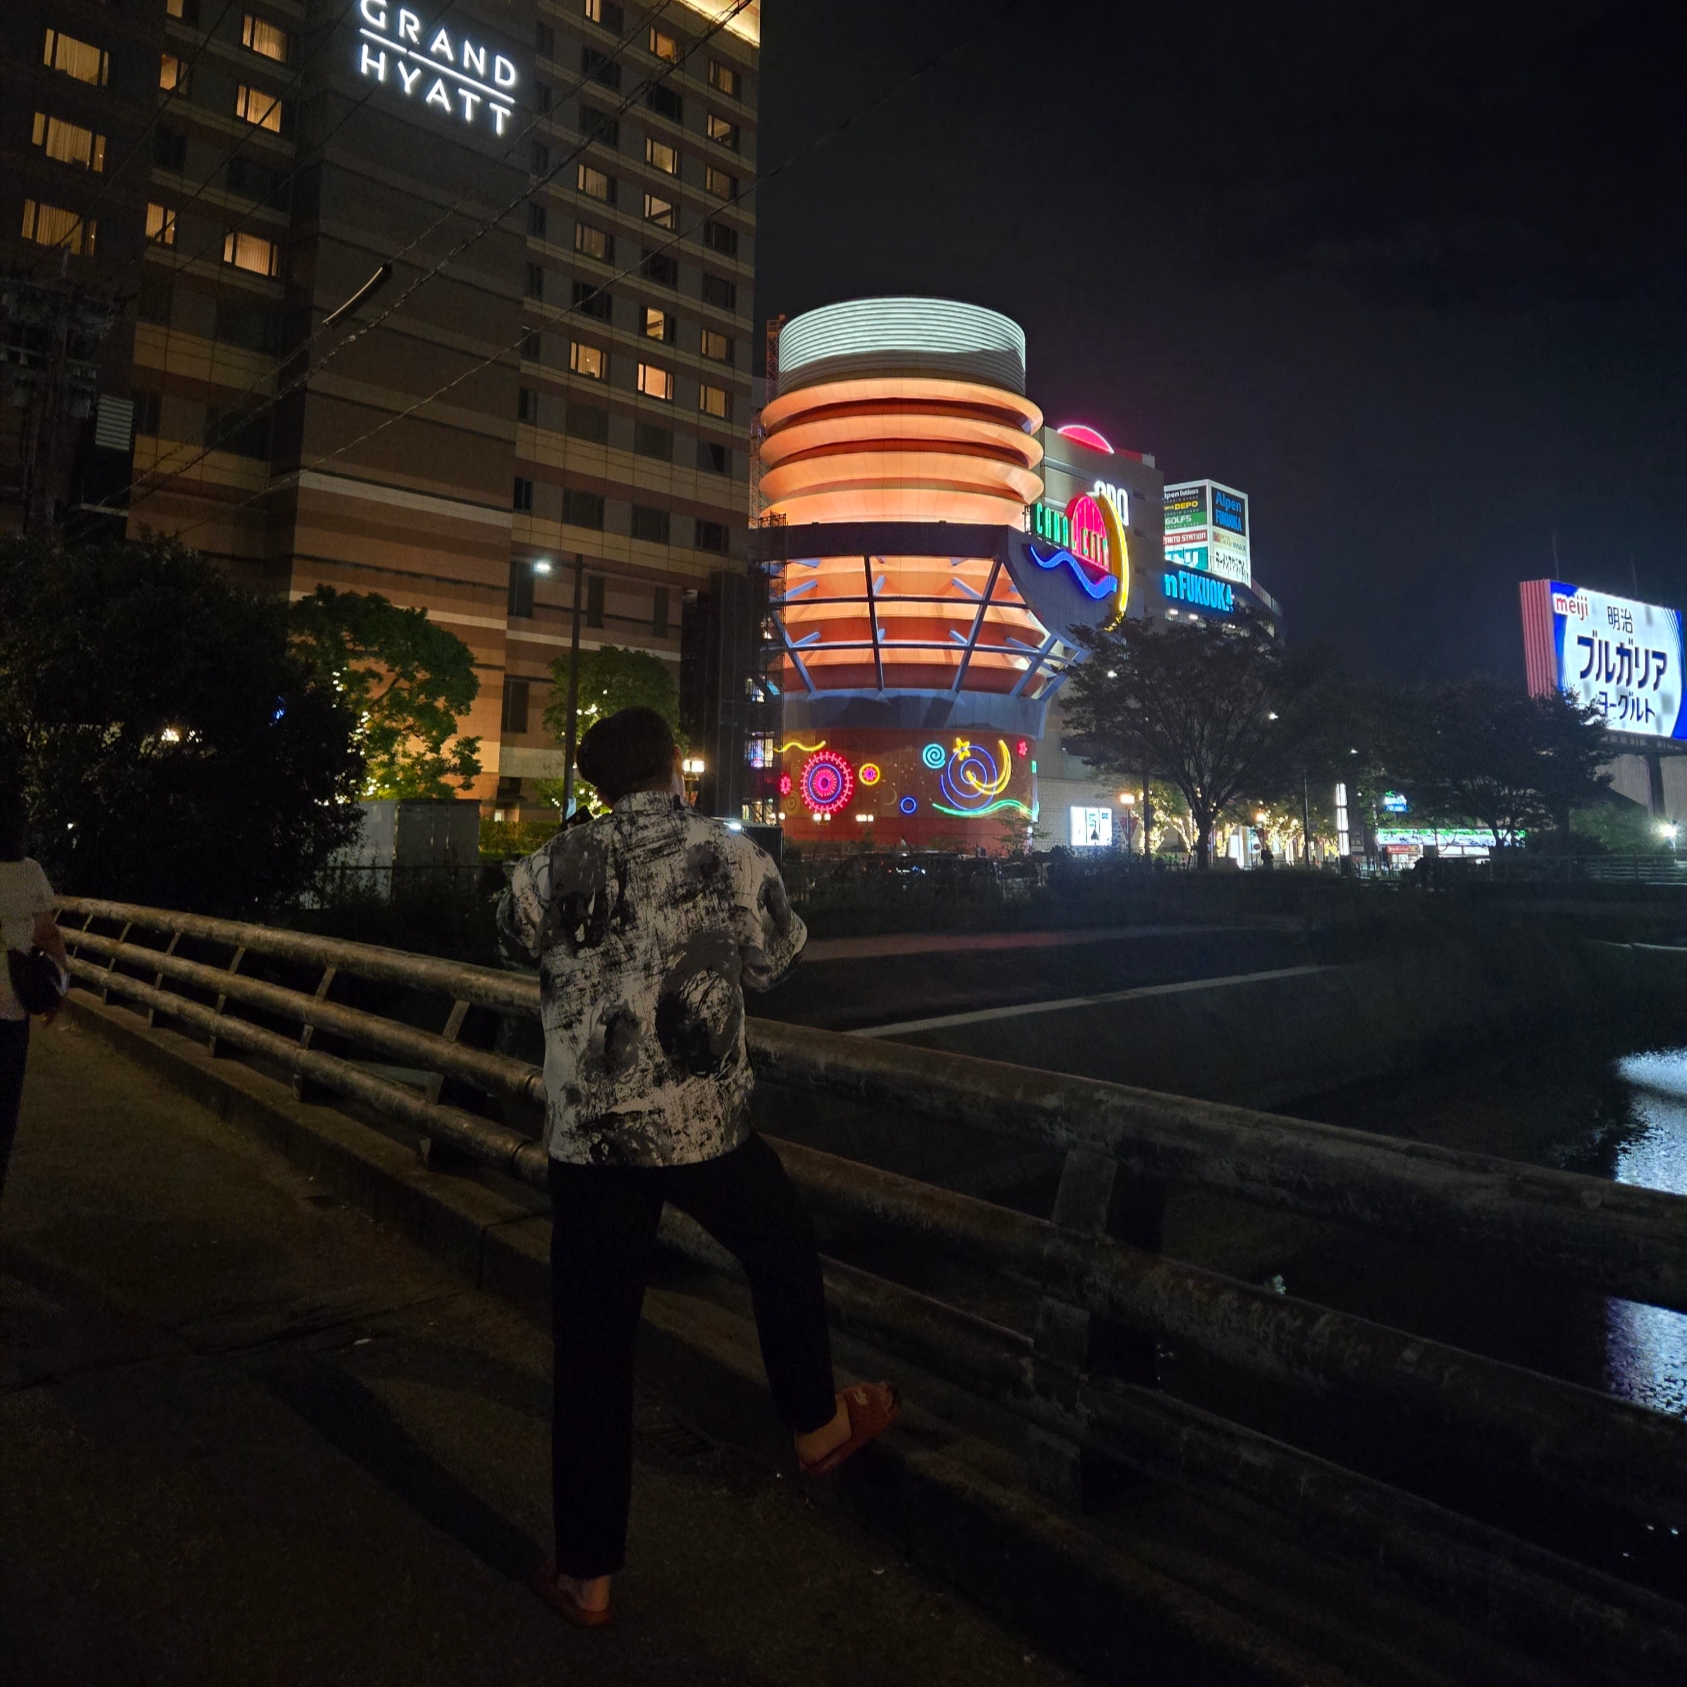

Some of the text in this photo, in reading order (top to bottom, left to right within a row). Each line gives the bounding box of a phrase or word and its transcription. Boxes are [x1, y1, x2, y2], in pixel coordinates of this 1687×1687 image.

[360, 0, 518, 87] GRAND
[360, 43, 512, 137] HYATT
[1164, 491, 1180, 500] lpen
[1174, 500, 1199, 511] DEPO
[1215, 491, 1242, 513] Alpen
[1165, 514, 1192, 525] GOLF5
[1215, 509, 1243, 532] FUKUOKA
[1036, 502, 1110, 567] CANAL CITY
[1181, 531, 1206, 542] STATION
[1178, 570, 1234, 612] FUKUOKA
[1556, 596, 1589, 621] meiji
[1606, 605, 1634, 634] 明治
[1577, 629, 1668, 692] ブルガリア
[1598, 691, 1656, 723] ヨーグルト
